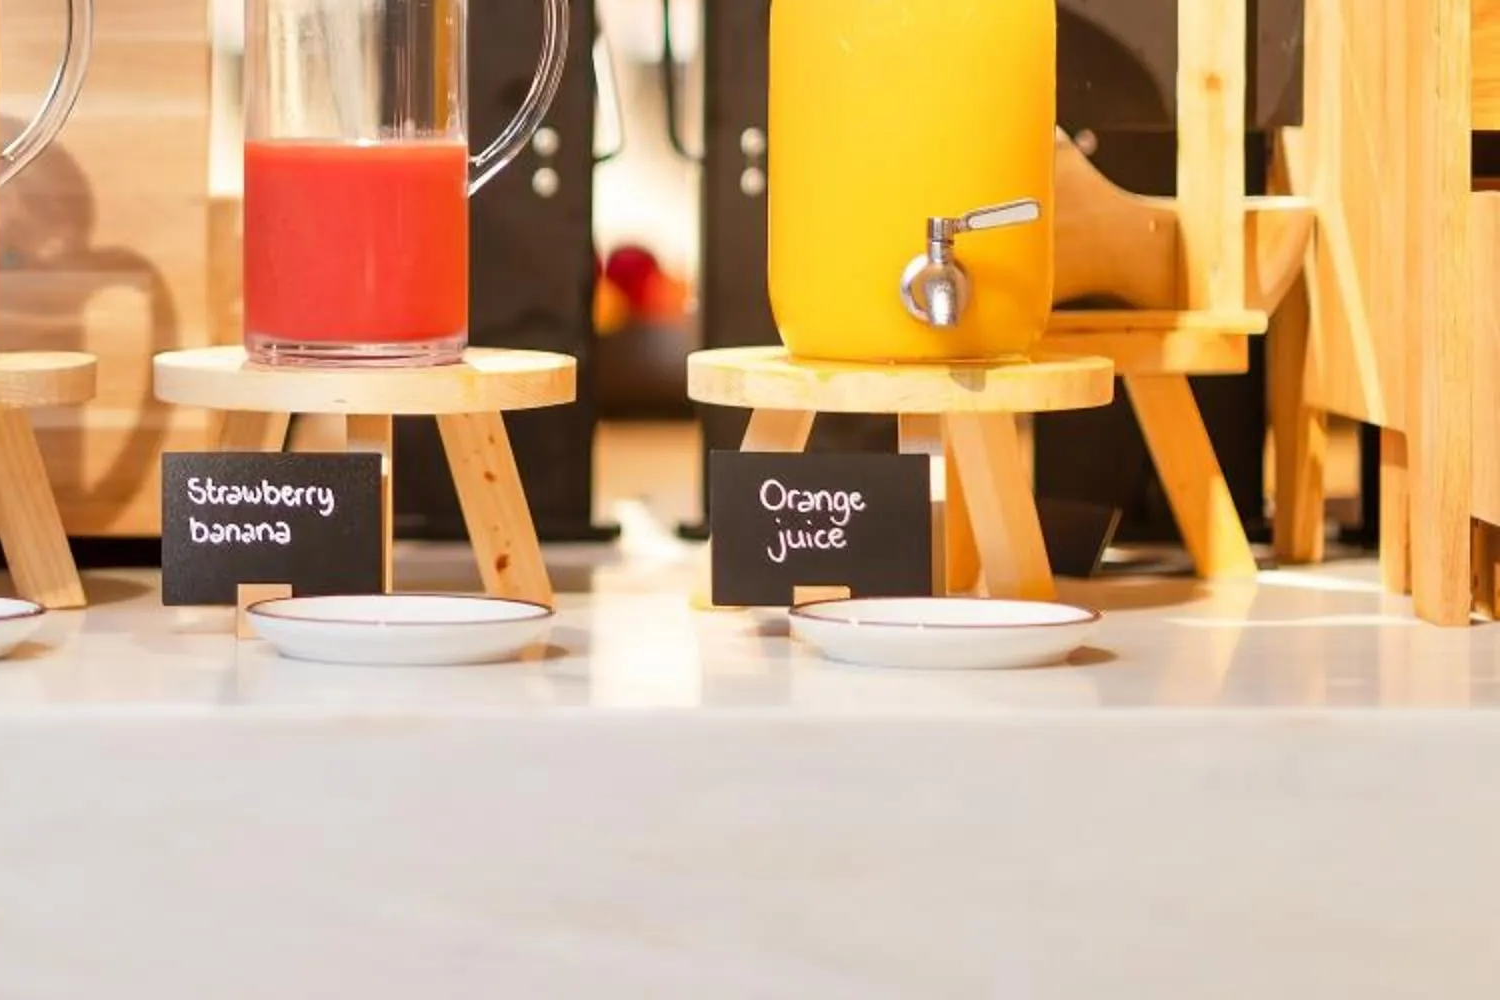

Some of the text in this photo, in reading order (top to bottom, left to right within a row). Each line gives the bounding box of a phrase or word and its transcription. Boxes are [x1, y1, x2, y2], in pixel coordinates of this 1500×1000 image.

[187, 476, 336, 518] Strawberry
[758, 478, 867, 527] Orange
[188, 516, 292, 546] banana
[766, 517, 848, 564] juice
